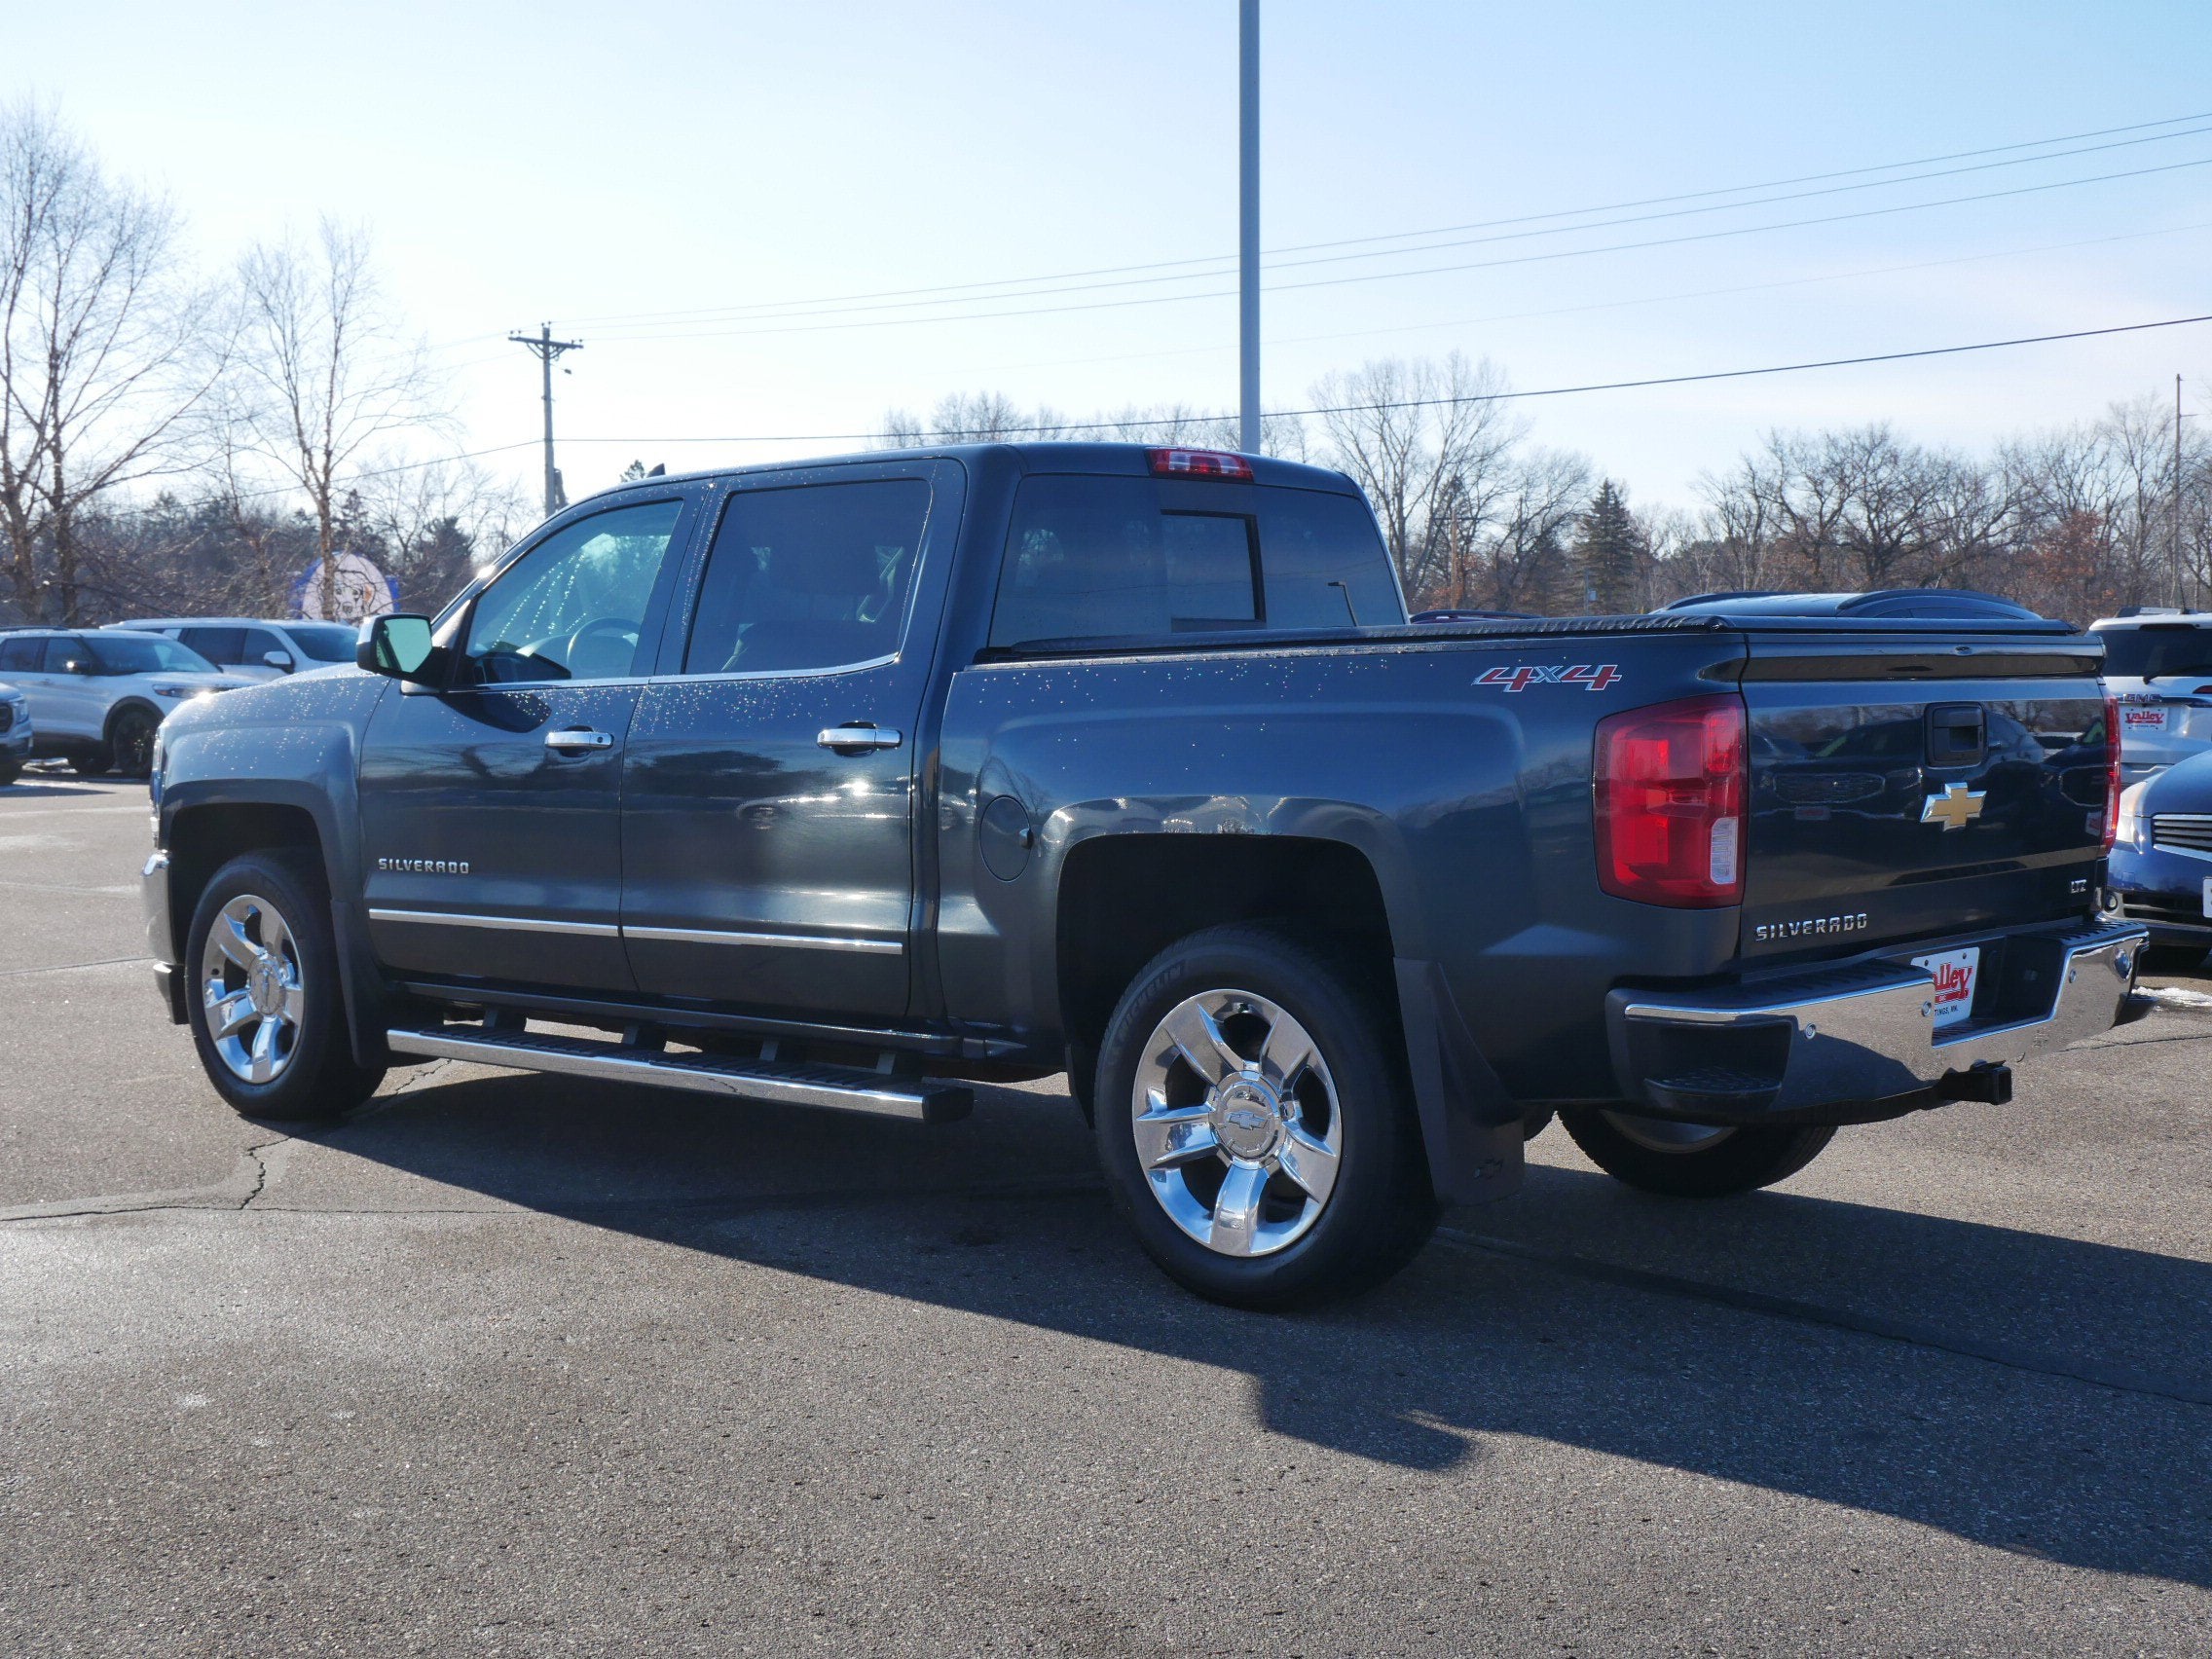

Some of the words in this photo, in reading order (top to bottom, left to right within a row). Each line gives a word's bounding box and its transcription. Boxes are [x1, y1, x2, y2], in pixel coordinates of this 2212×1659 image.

[2123, 693, 2161, 702] GMC
[378, 858, 469, 874] SILVERADO
[2071, 879, 2087, 894] LTZ
[1755, 913, 1867, 941] SILVERADO
[1933, 962, 1973, 1000] lley
